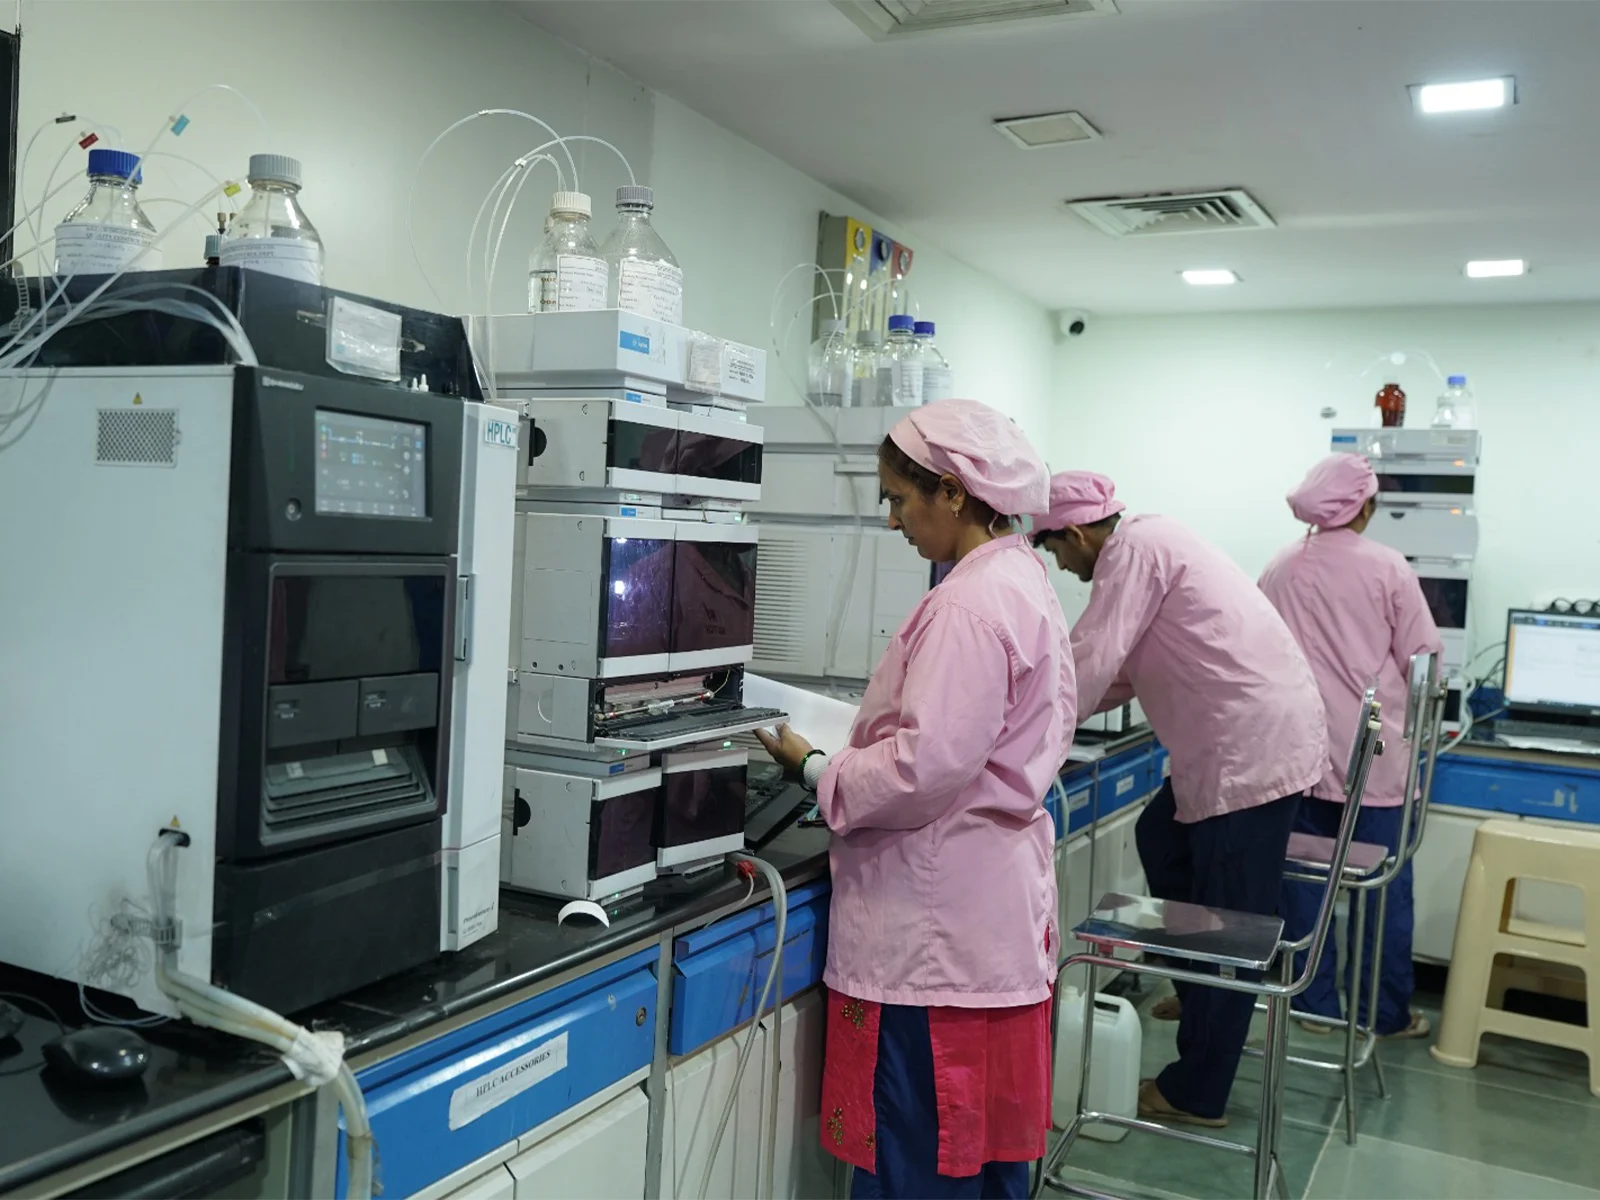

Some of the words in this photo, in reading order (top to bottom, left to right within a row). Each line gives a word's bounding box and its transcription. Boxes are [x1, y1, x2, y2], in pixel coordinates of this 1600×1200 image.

[487, 421, 511, 444] HPLC
[476, 1076, 499, 1097] HPLC
[501, 1049, 551, 1083] ACCESSORIES
